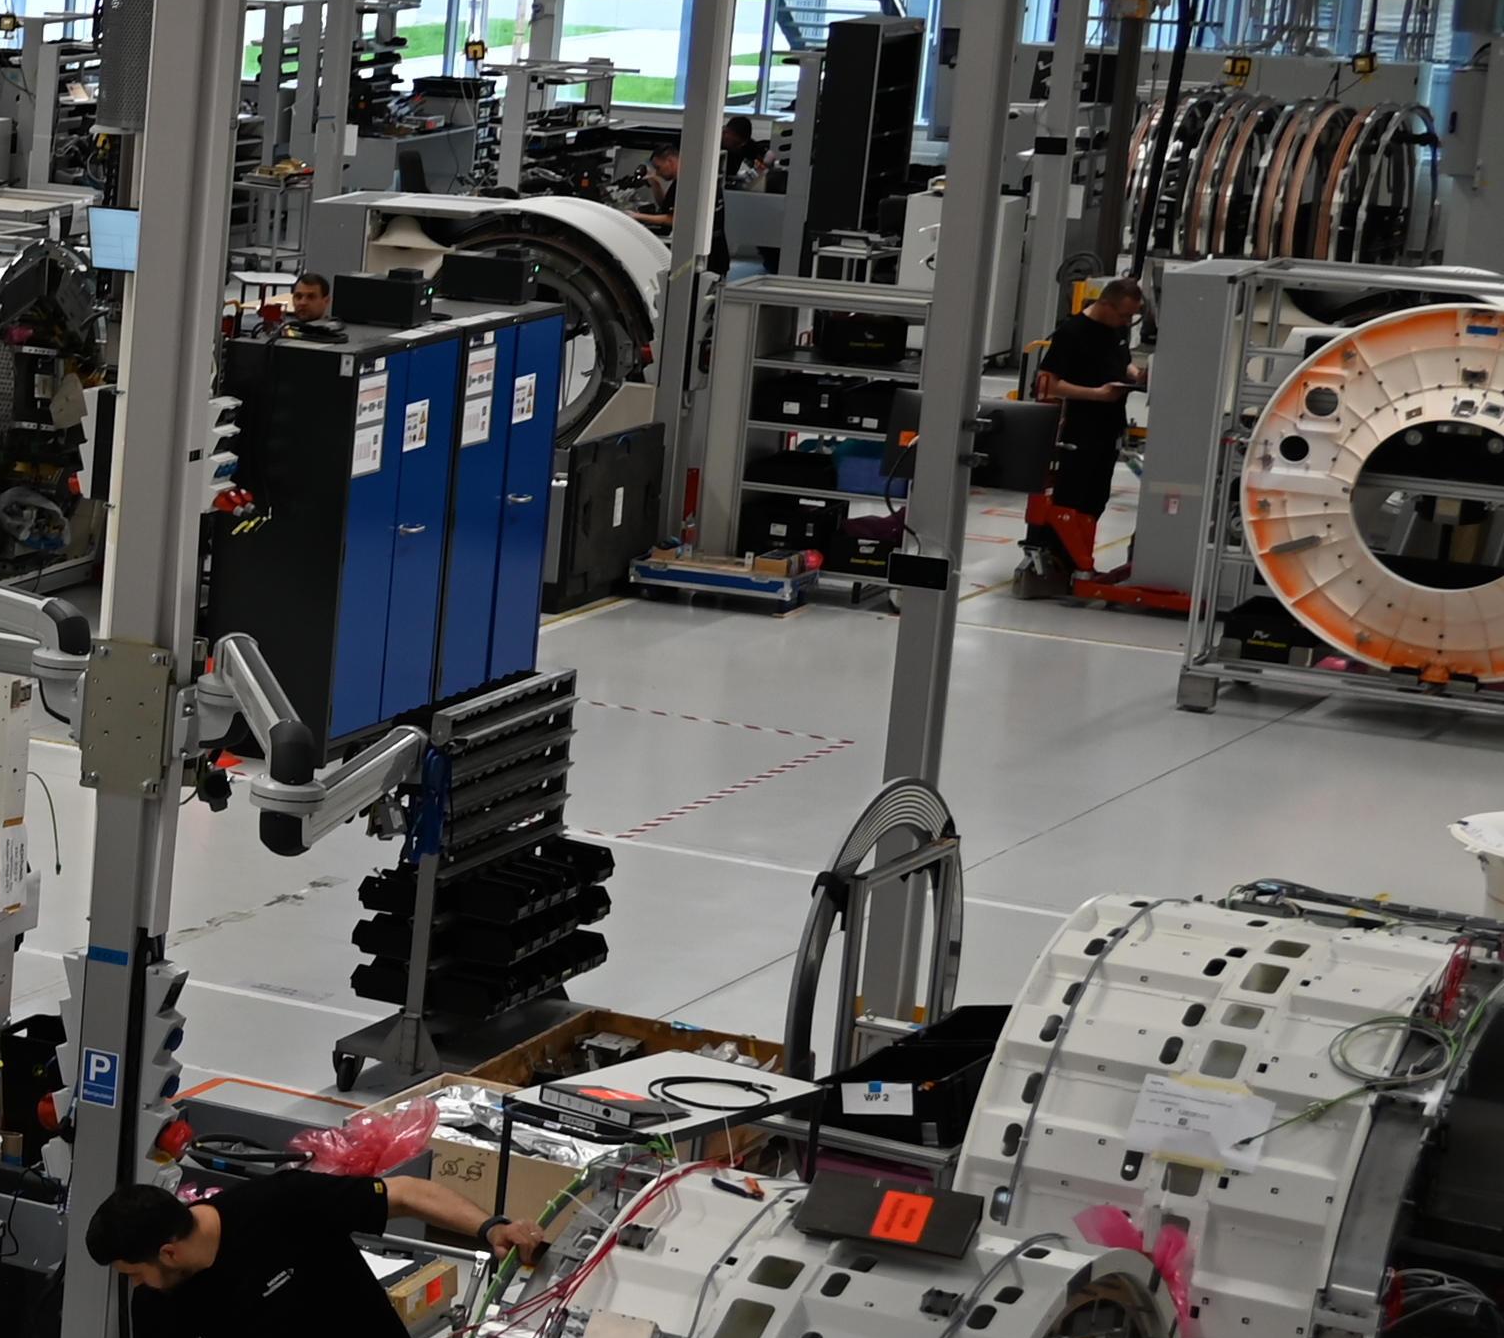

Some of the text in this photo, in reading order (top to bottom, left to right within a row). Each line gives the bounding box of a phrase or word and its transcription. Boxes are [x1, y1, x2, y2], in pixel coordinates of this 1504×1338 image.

[89, 1054, 111, 1081] P
[864, 1093, 889, 1102] WP 2
